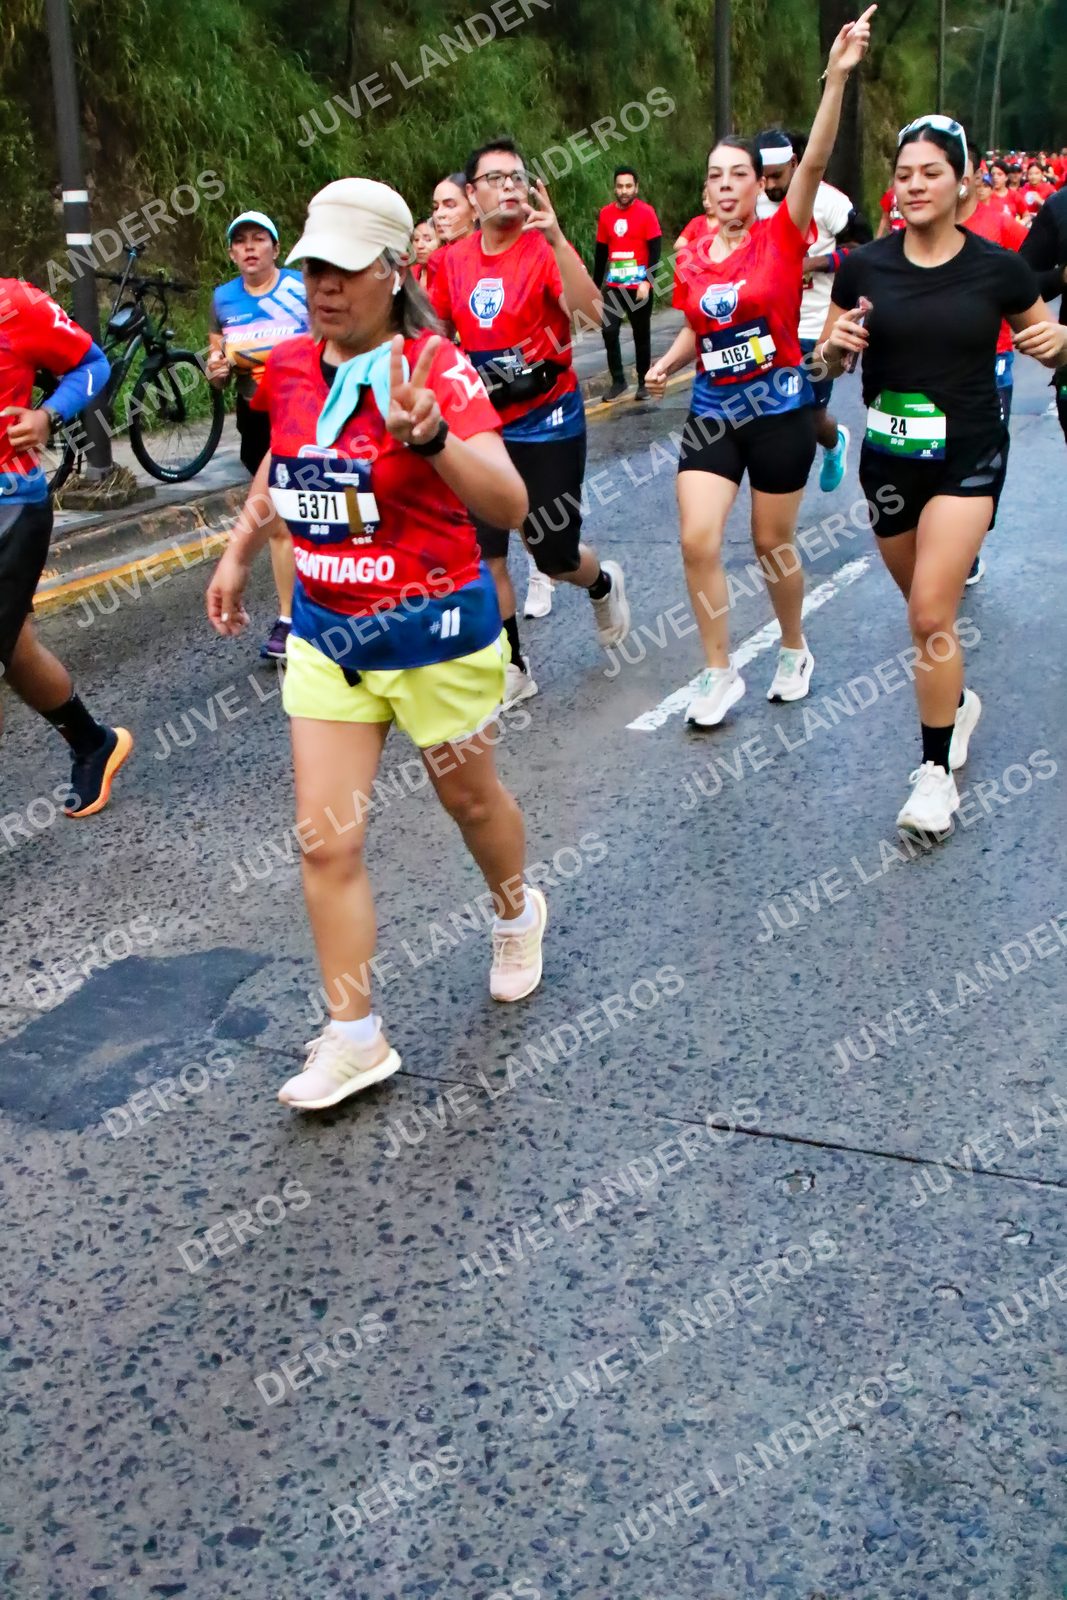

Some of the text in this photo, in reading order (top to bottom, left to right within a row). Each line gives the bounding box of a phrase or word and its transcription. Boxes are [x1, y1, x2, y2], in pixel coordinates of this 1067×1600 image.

[721, 345, 751, 365] 4162
[890, 417, 907, 436] 24
[298, 493, 339, 520] 5371
